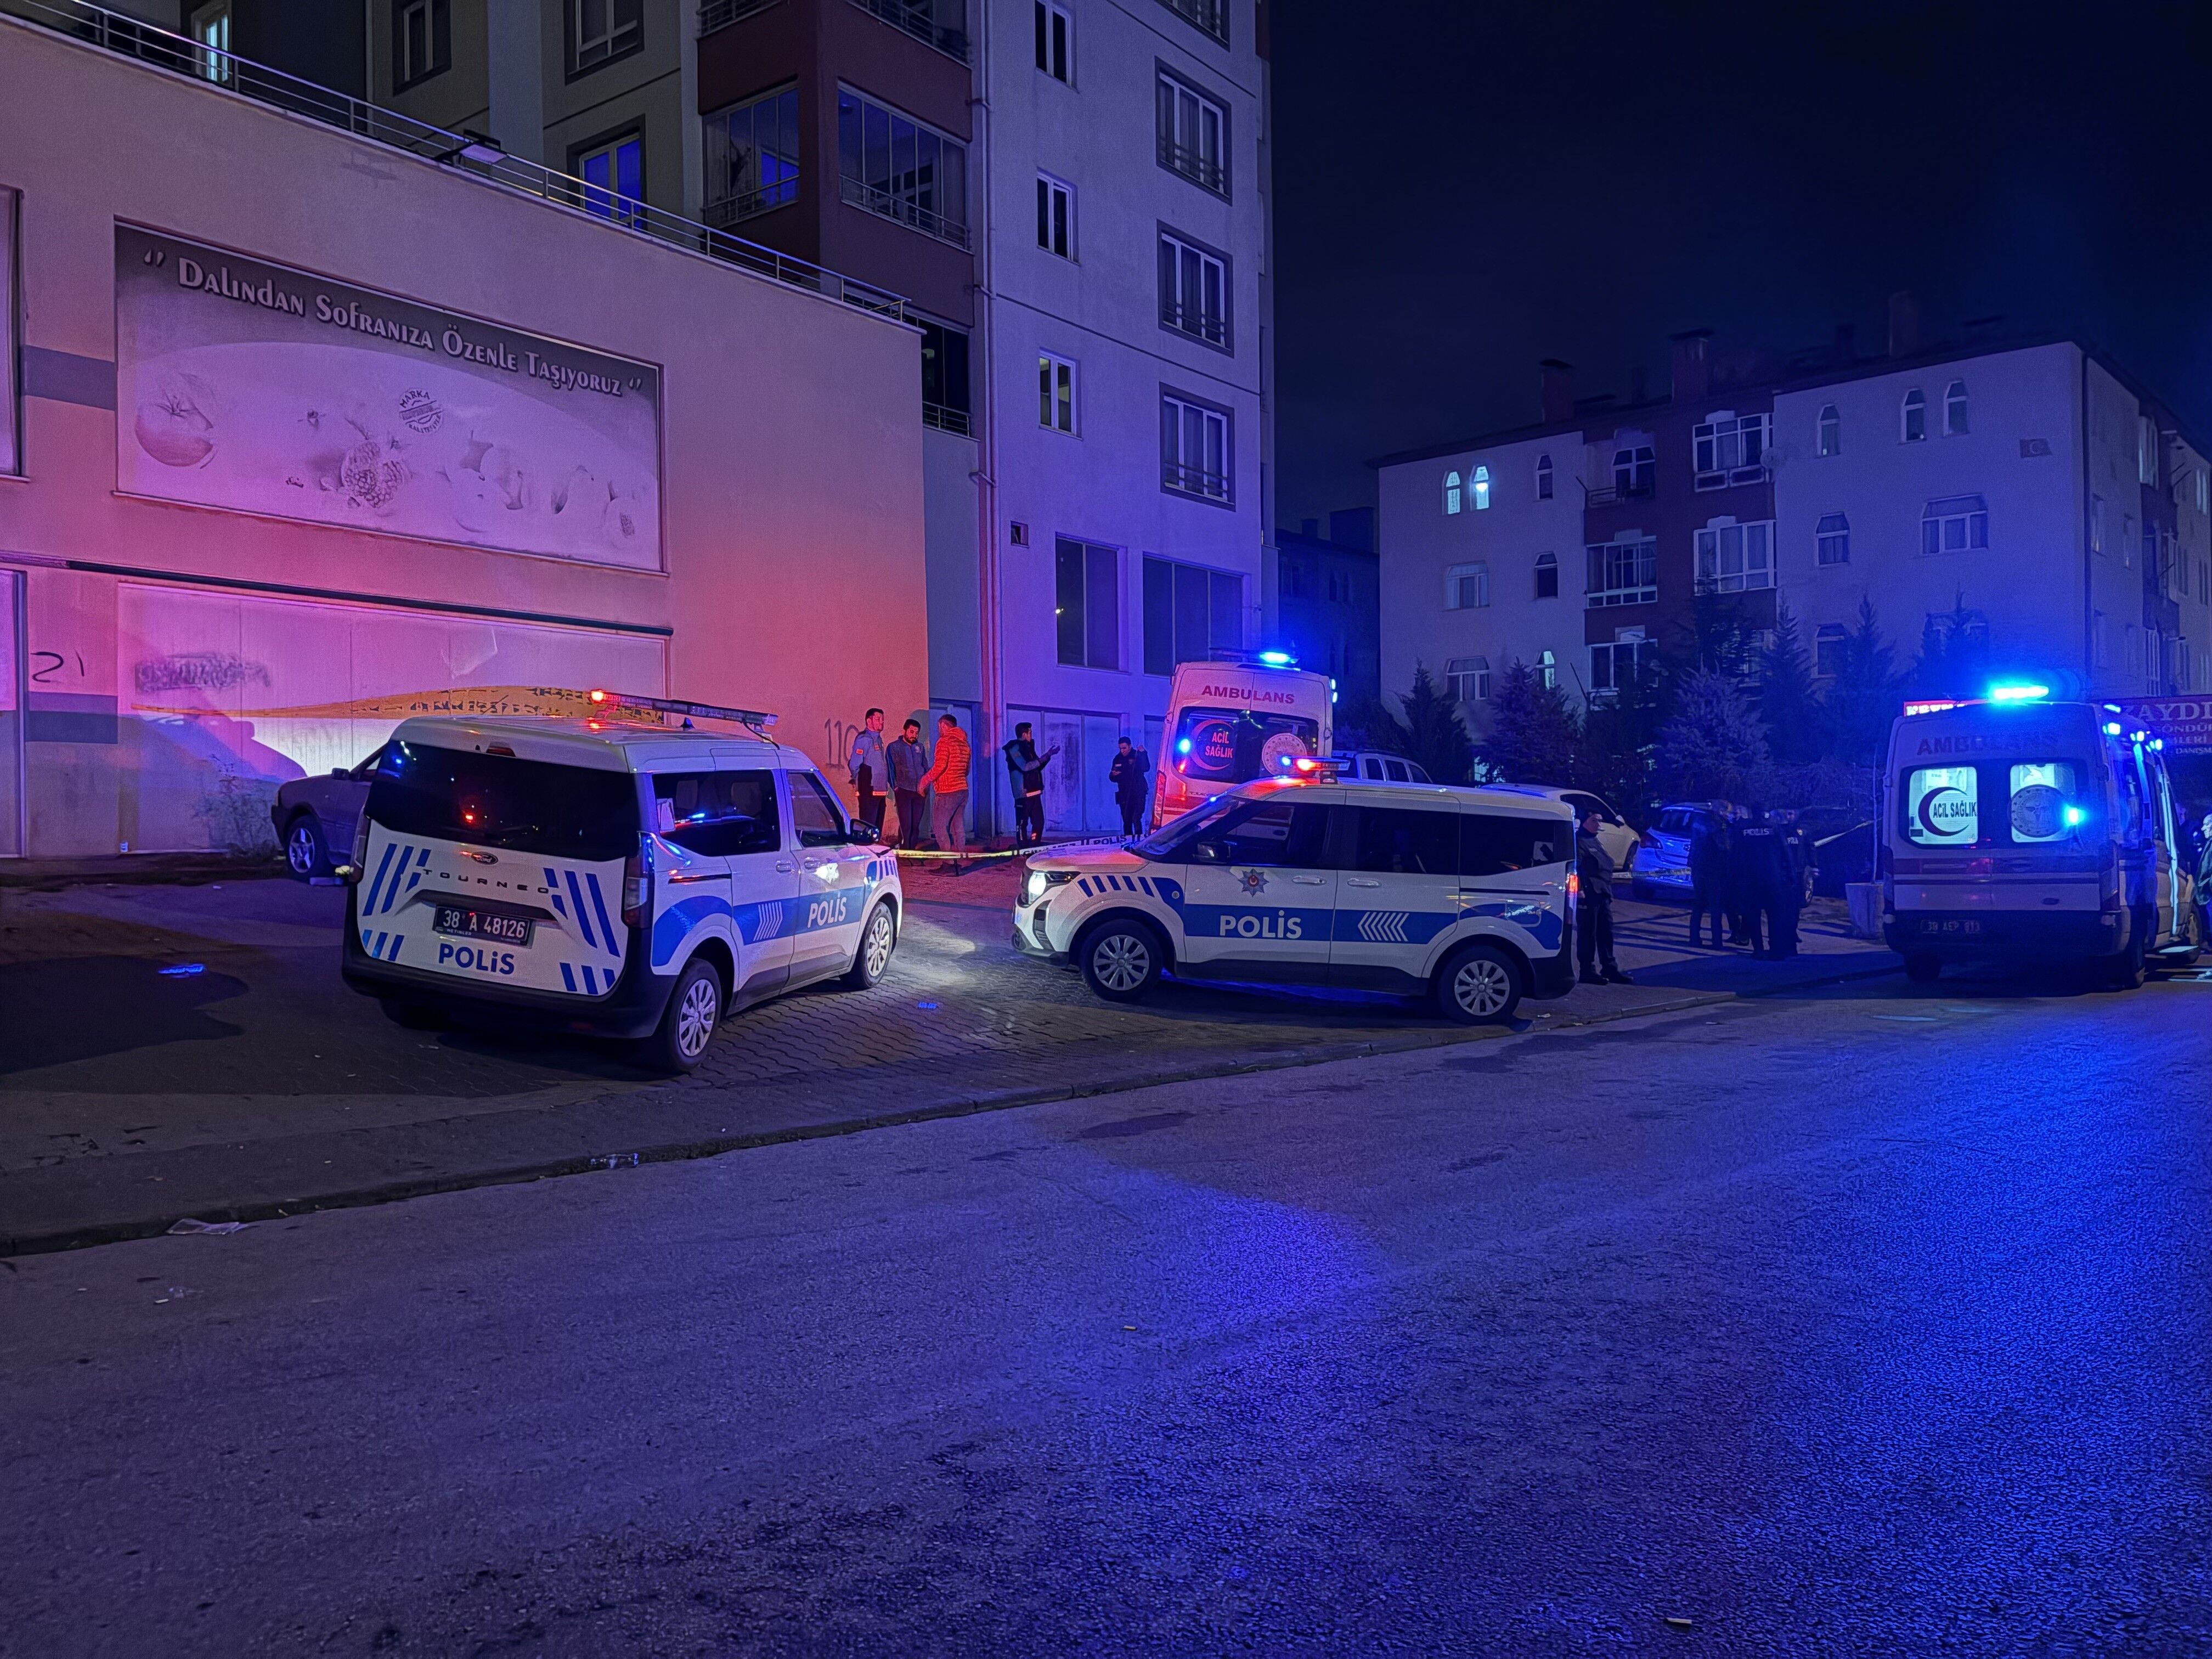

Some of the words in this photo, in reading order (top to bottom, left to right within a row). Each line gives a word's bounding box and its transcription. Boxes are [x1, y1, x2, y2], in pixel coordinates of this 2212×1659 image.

[399, 390, 430, 409] MARKA
[1201, 685, 1295, 704] AMBULANS
[1205, 744, 1234, 759] SAĞLIK
[1950, 800, 1977, 817] SAĞLIK
[423, 868, 549, 894] TOURNEO
[807, 890, 848, 928] POLİS
[443, 910, 460, 928] 38
[469, 913, 477, 932] A
[483, 916, 526, 938] 48126
[1220, 910, 1302, 939] POLİS
